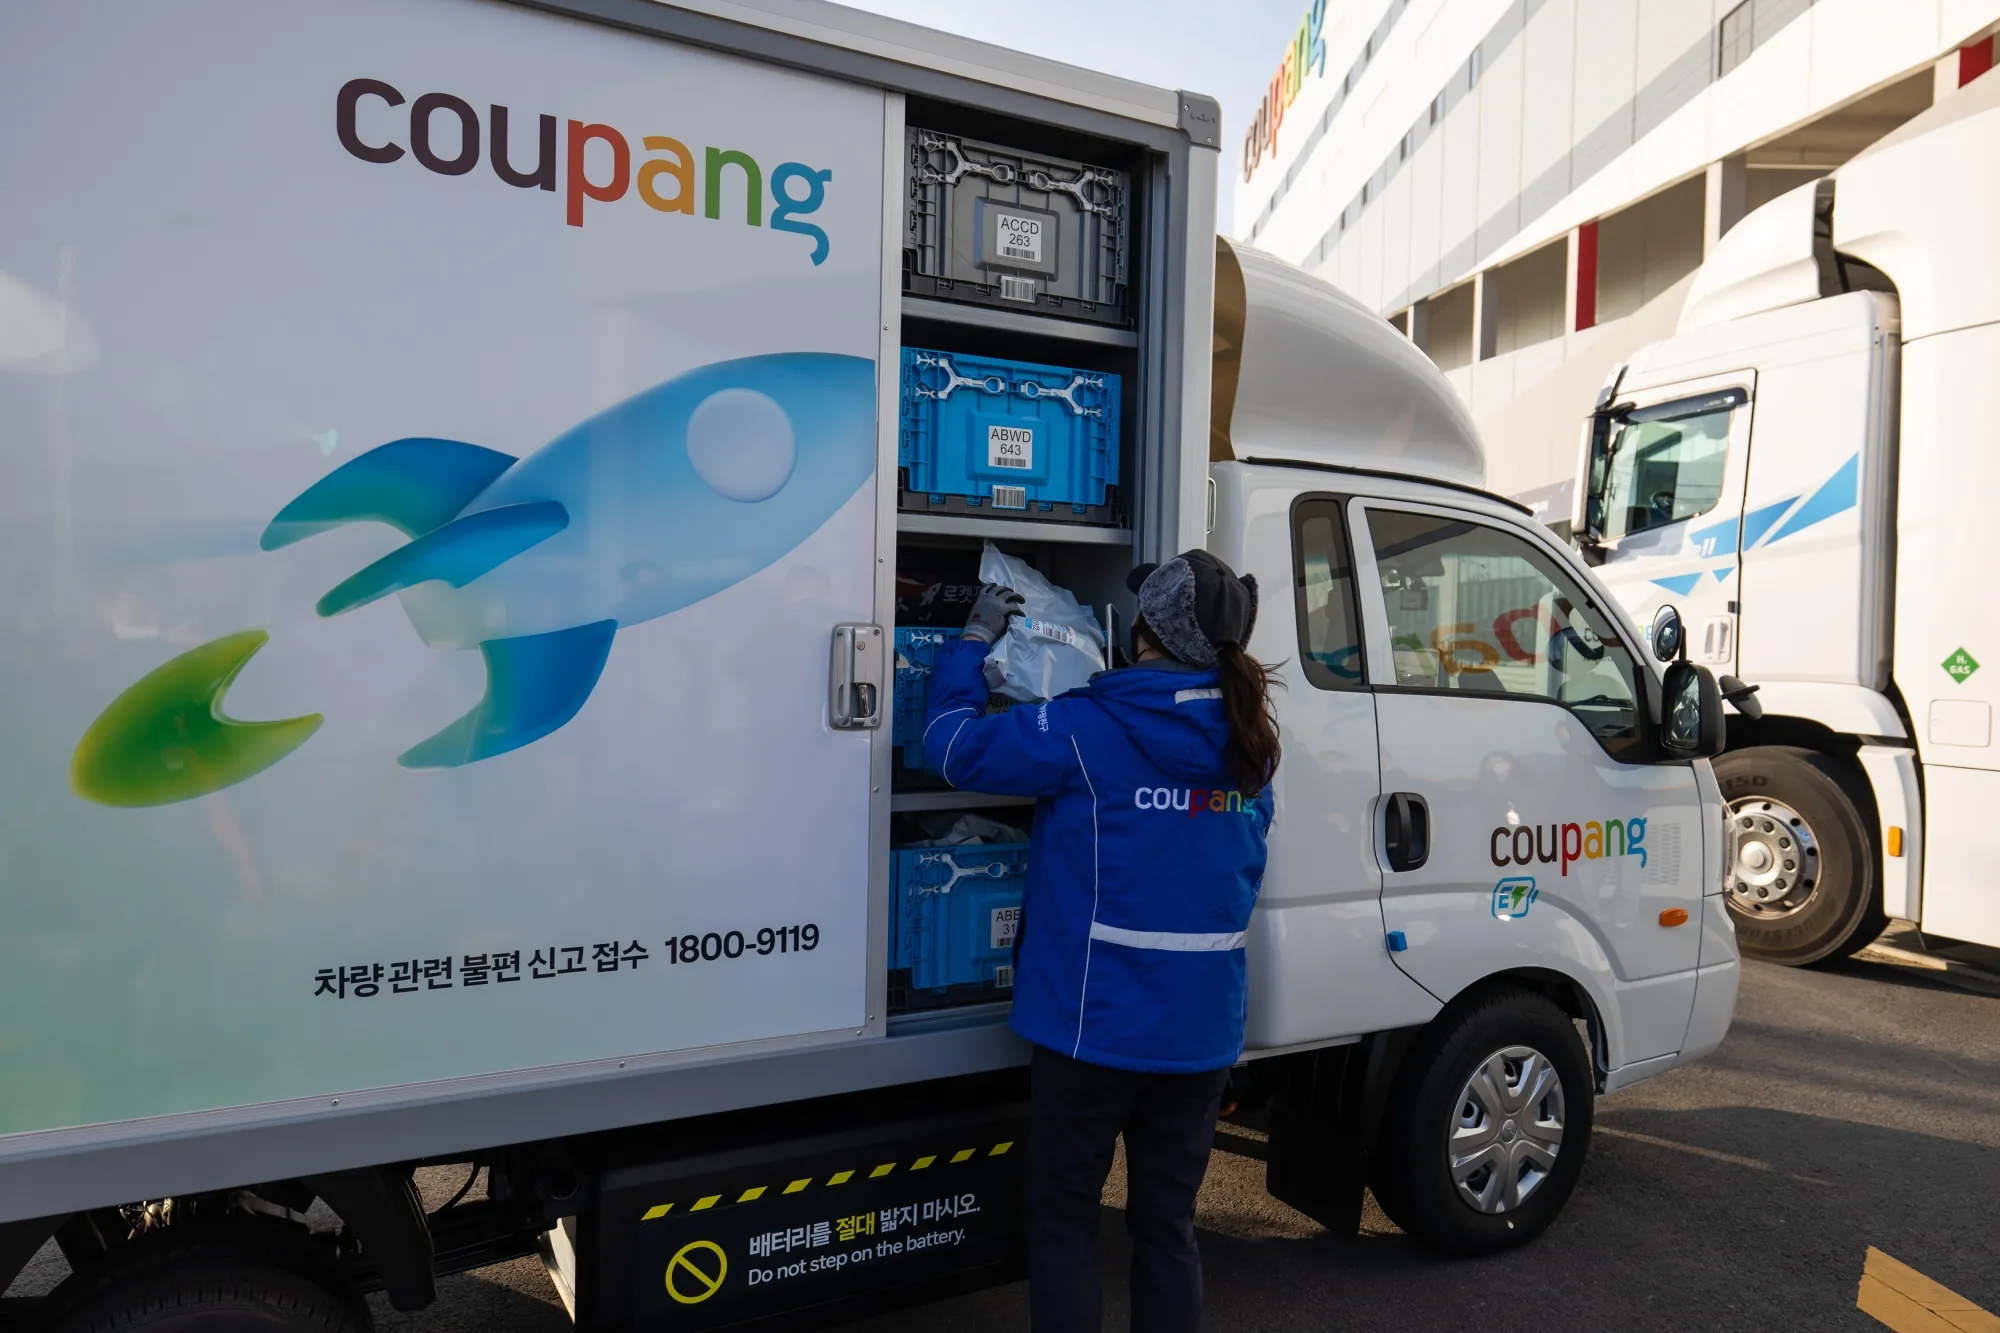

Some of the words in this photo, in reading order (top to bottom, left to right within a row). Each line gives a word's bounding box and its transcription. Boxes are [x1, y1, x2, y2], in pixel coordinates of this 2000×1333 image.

[1244, 0, 1326, 183] coupang
[336, 78, 833, 267] coupang
[1000, 217, 1039, 235] ACCD
[1009, 233, 1030, 247] 263
[990, 428, 1031, 443] ABWD
[1000, 443, 1021, 456] 643
[1490, 817, 1648, 877] coupang
[314, 965, 385, 1000] 차량
[388, 956, 453, 995] 관련
[458, 952, 521, 987] 불편
[527, 946, 588, 980] 신고
[592, 939, 650, 973] 접수
[665, 923, 820, 965] 1800-9119
[750, 1221, 832, 1257] 배터리를
[836, 1211, 876, 1242] 절대
[880, 1203, 918, 1233] 밟지
[923, 1193, 981, 1222] 마시오.
[748, 1268, 774, 1286] Do
[777, 1259, 807, 1280] not
[810, 1253, 848, 1271] step
[851, 1248, 873, 1263] on
[876, 1240, 904, 1257] the
[906, 1228, 966, 1252] battery.
